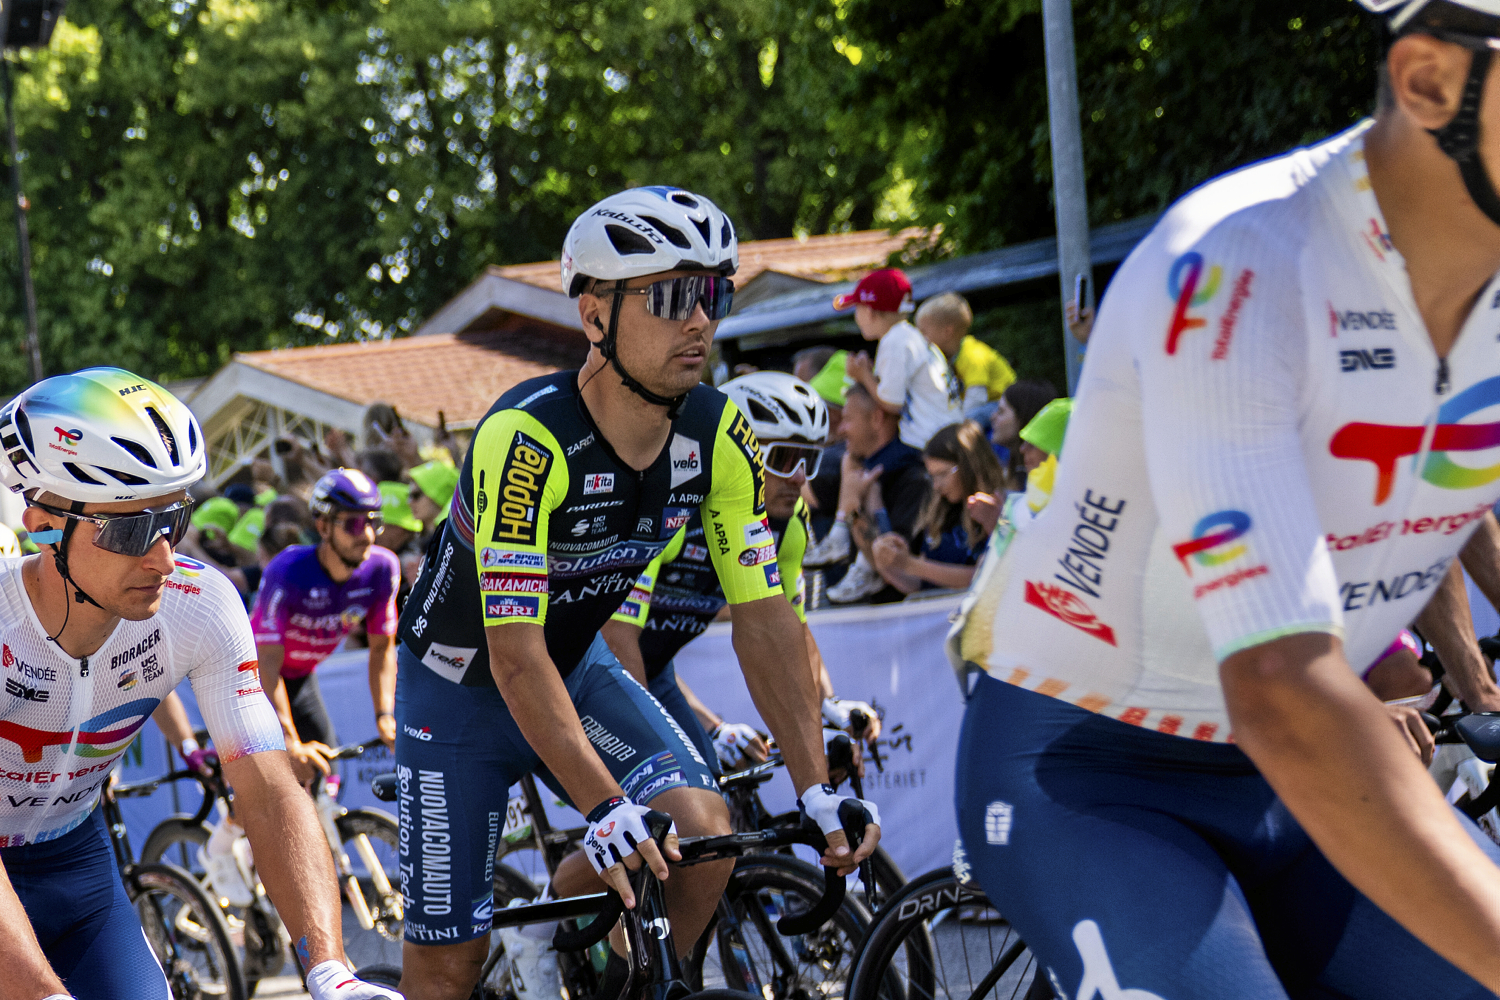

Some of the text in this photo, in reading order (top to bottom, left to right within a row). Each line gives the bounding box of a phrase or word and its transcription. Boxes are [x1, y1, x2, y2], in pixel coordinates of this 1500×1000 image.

[48, 442, 78, 456] TotalEnergies
[1054, 487, 1127, 599] VENDÉE
[111, 628, 161, 670] BIORACER
[140, 653, 158, 668] UCI
[13, 657, 58, 682] VENDÉE
[418, 769, 452, 916] NUOVACOMAUTO
